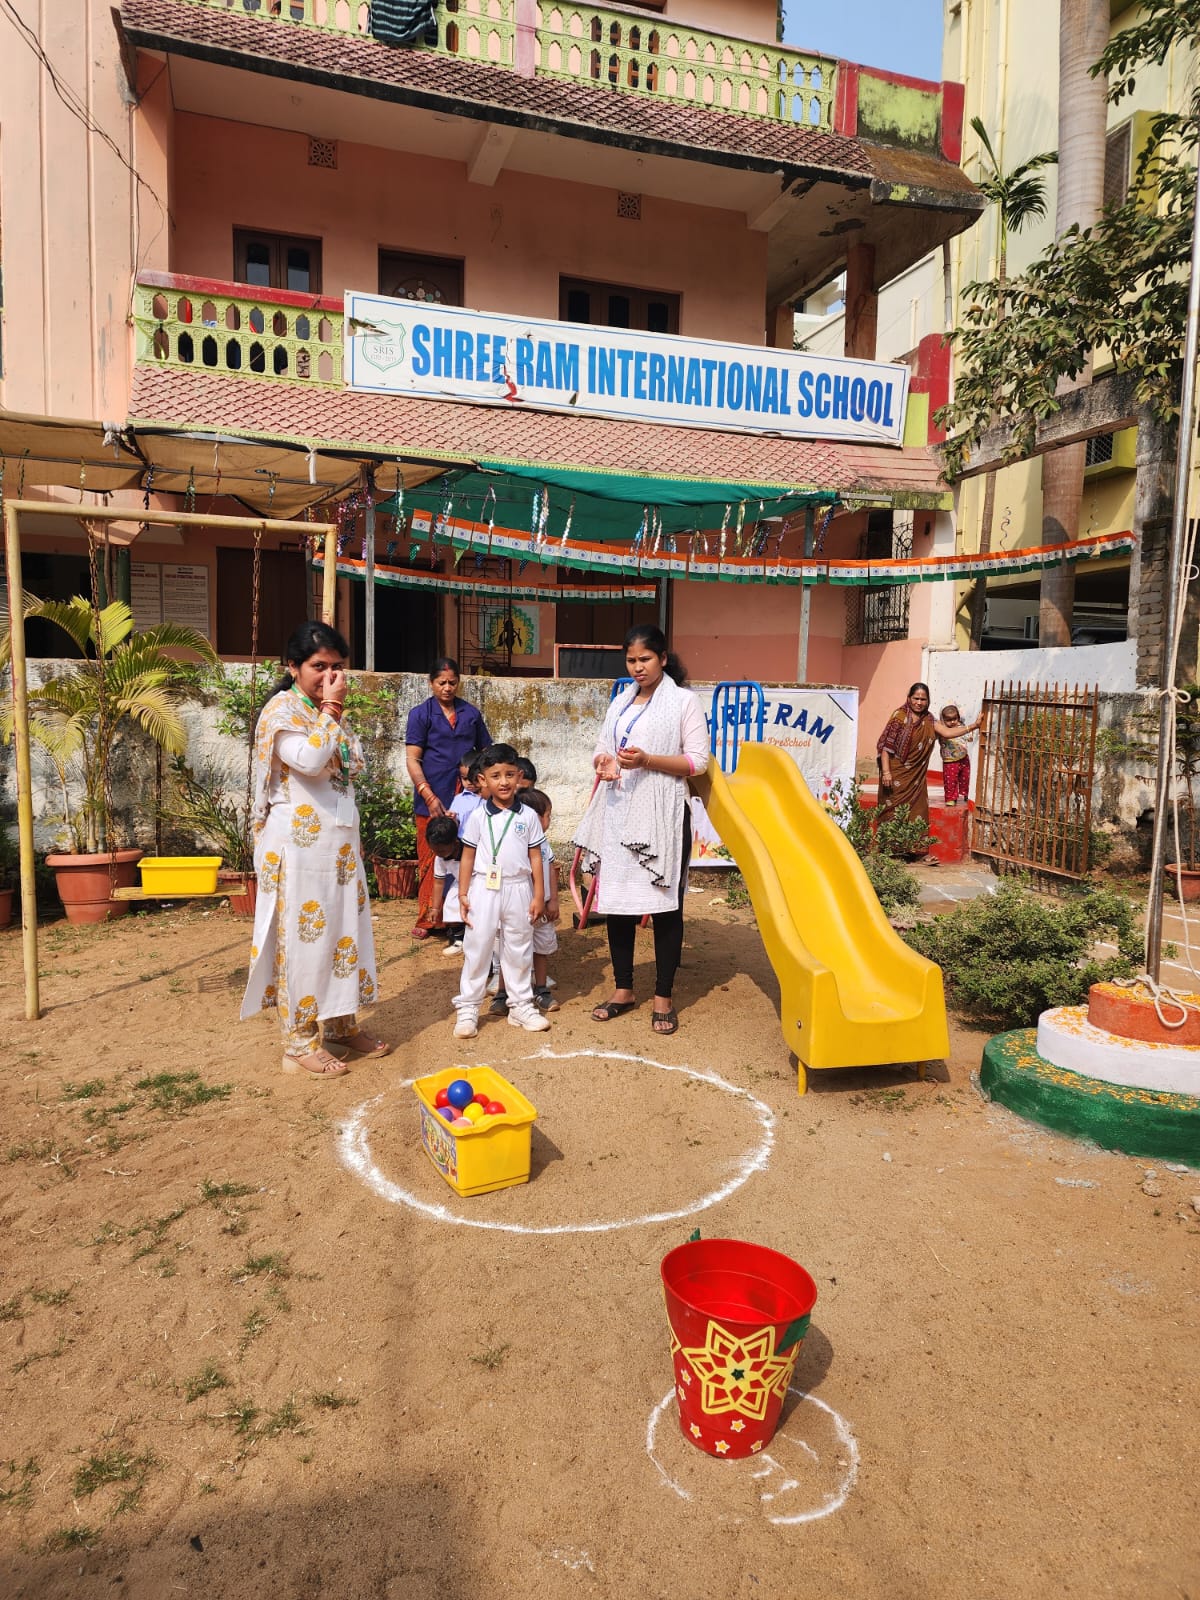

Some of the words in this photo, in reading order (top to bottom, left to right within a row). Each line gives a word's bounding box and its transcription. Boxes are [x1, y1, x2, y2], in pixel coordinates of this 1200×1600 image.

[373, 345, 394, 355] SRIS
[412, 324, 506, 384] SHREE
[516, 337, 579, 391] RAM
[588, 345, 791, 415] INTERNATIONAL
[798, 370, 894, 427] SCHOOL
[704, 702, 771, 734] HREE
[773, 703, 835, 744] RAM
